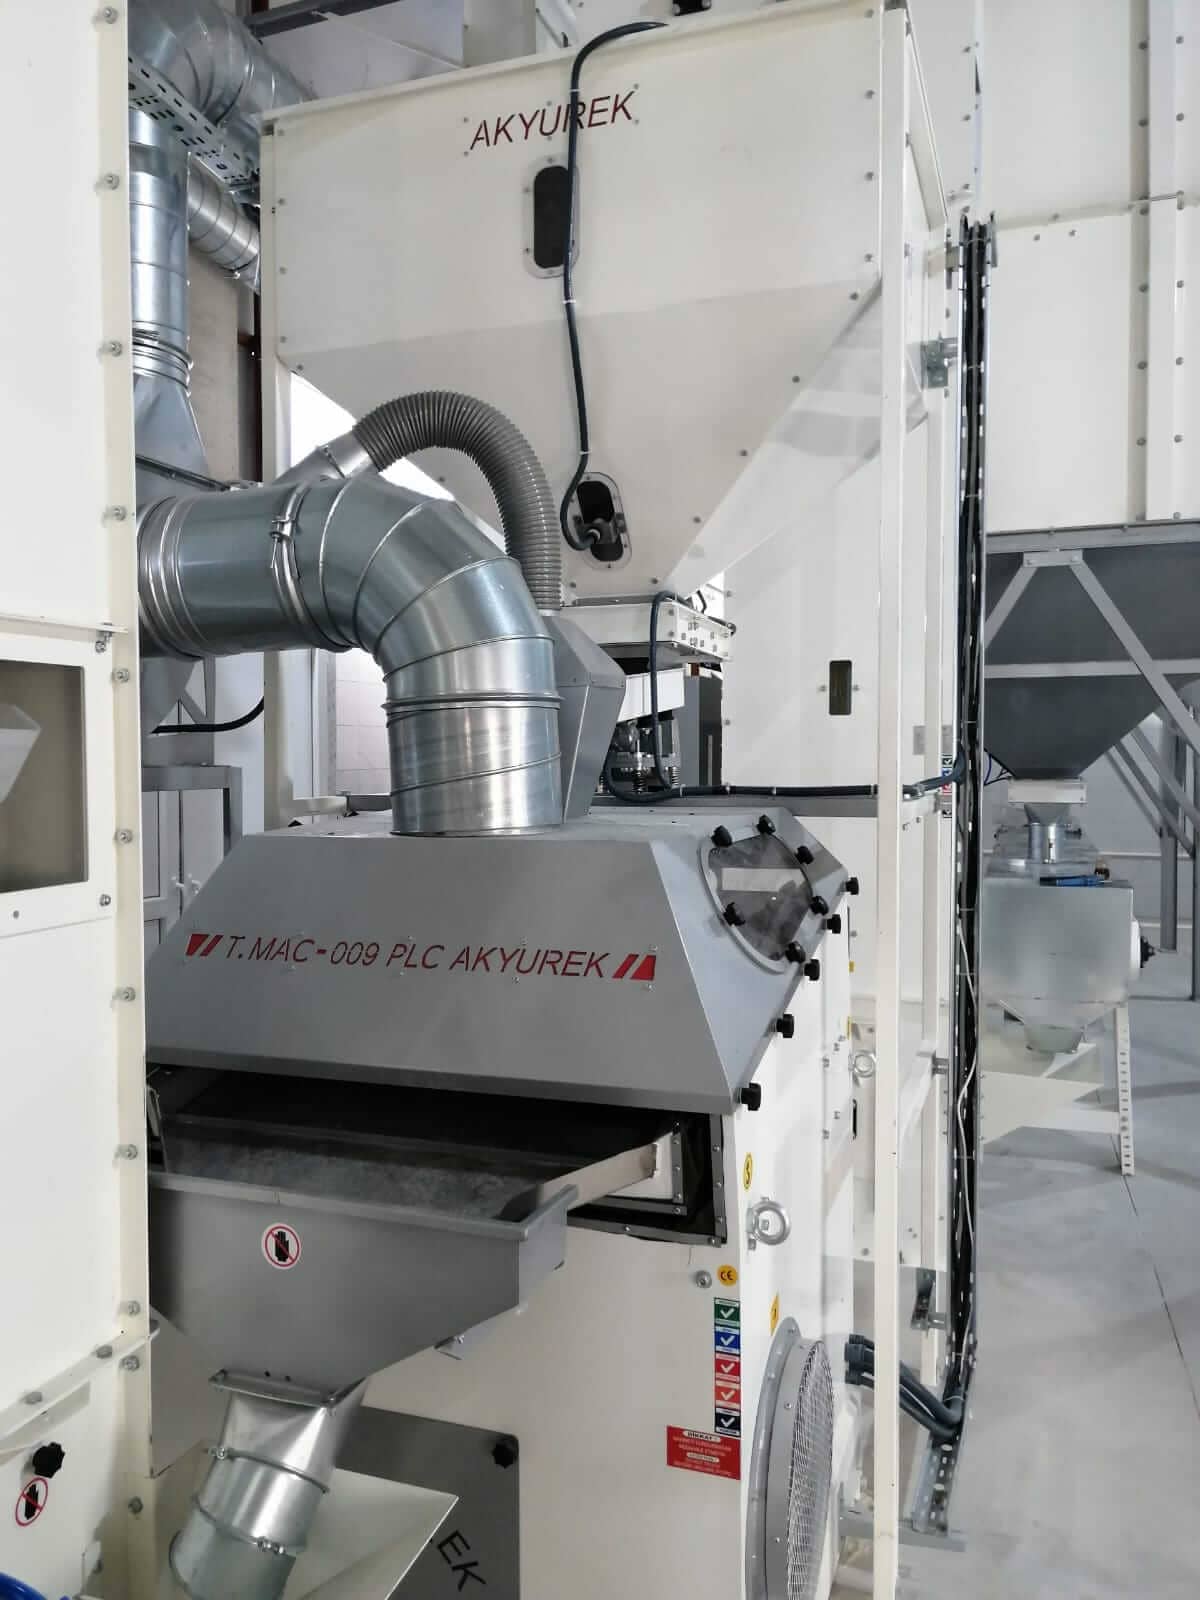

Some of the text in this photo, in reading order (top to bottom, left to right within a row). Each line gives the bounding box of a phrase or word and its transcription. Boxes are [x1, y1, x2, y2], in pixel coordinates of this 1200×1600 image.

[469, 89, 636, 151] AKYUREK
[385, 942, 446, 970] PLC
[448, 945, 612, 979] AKYUREK
[430, 1529, 487, 1593] EK
